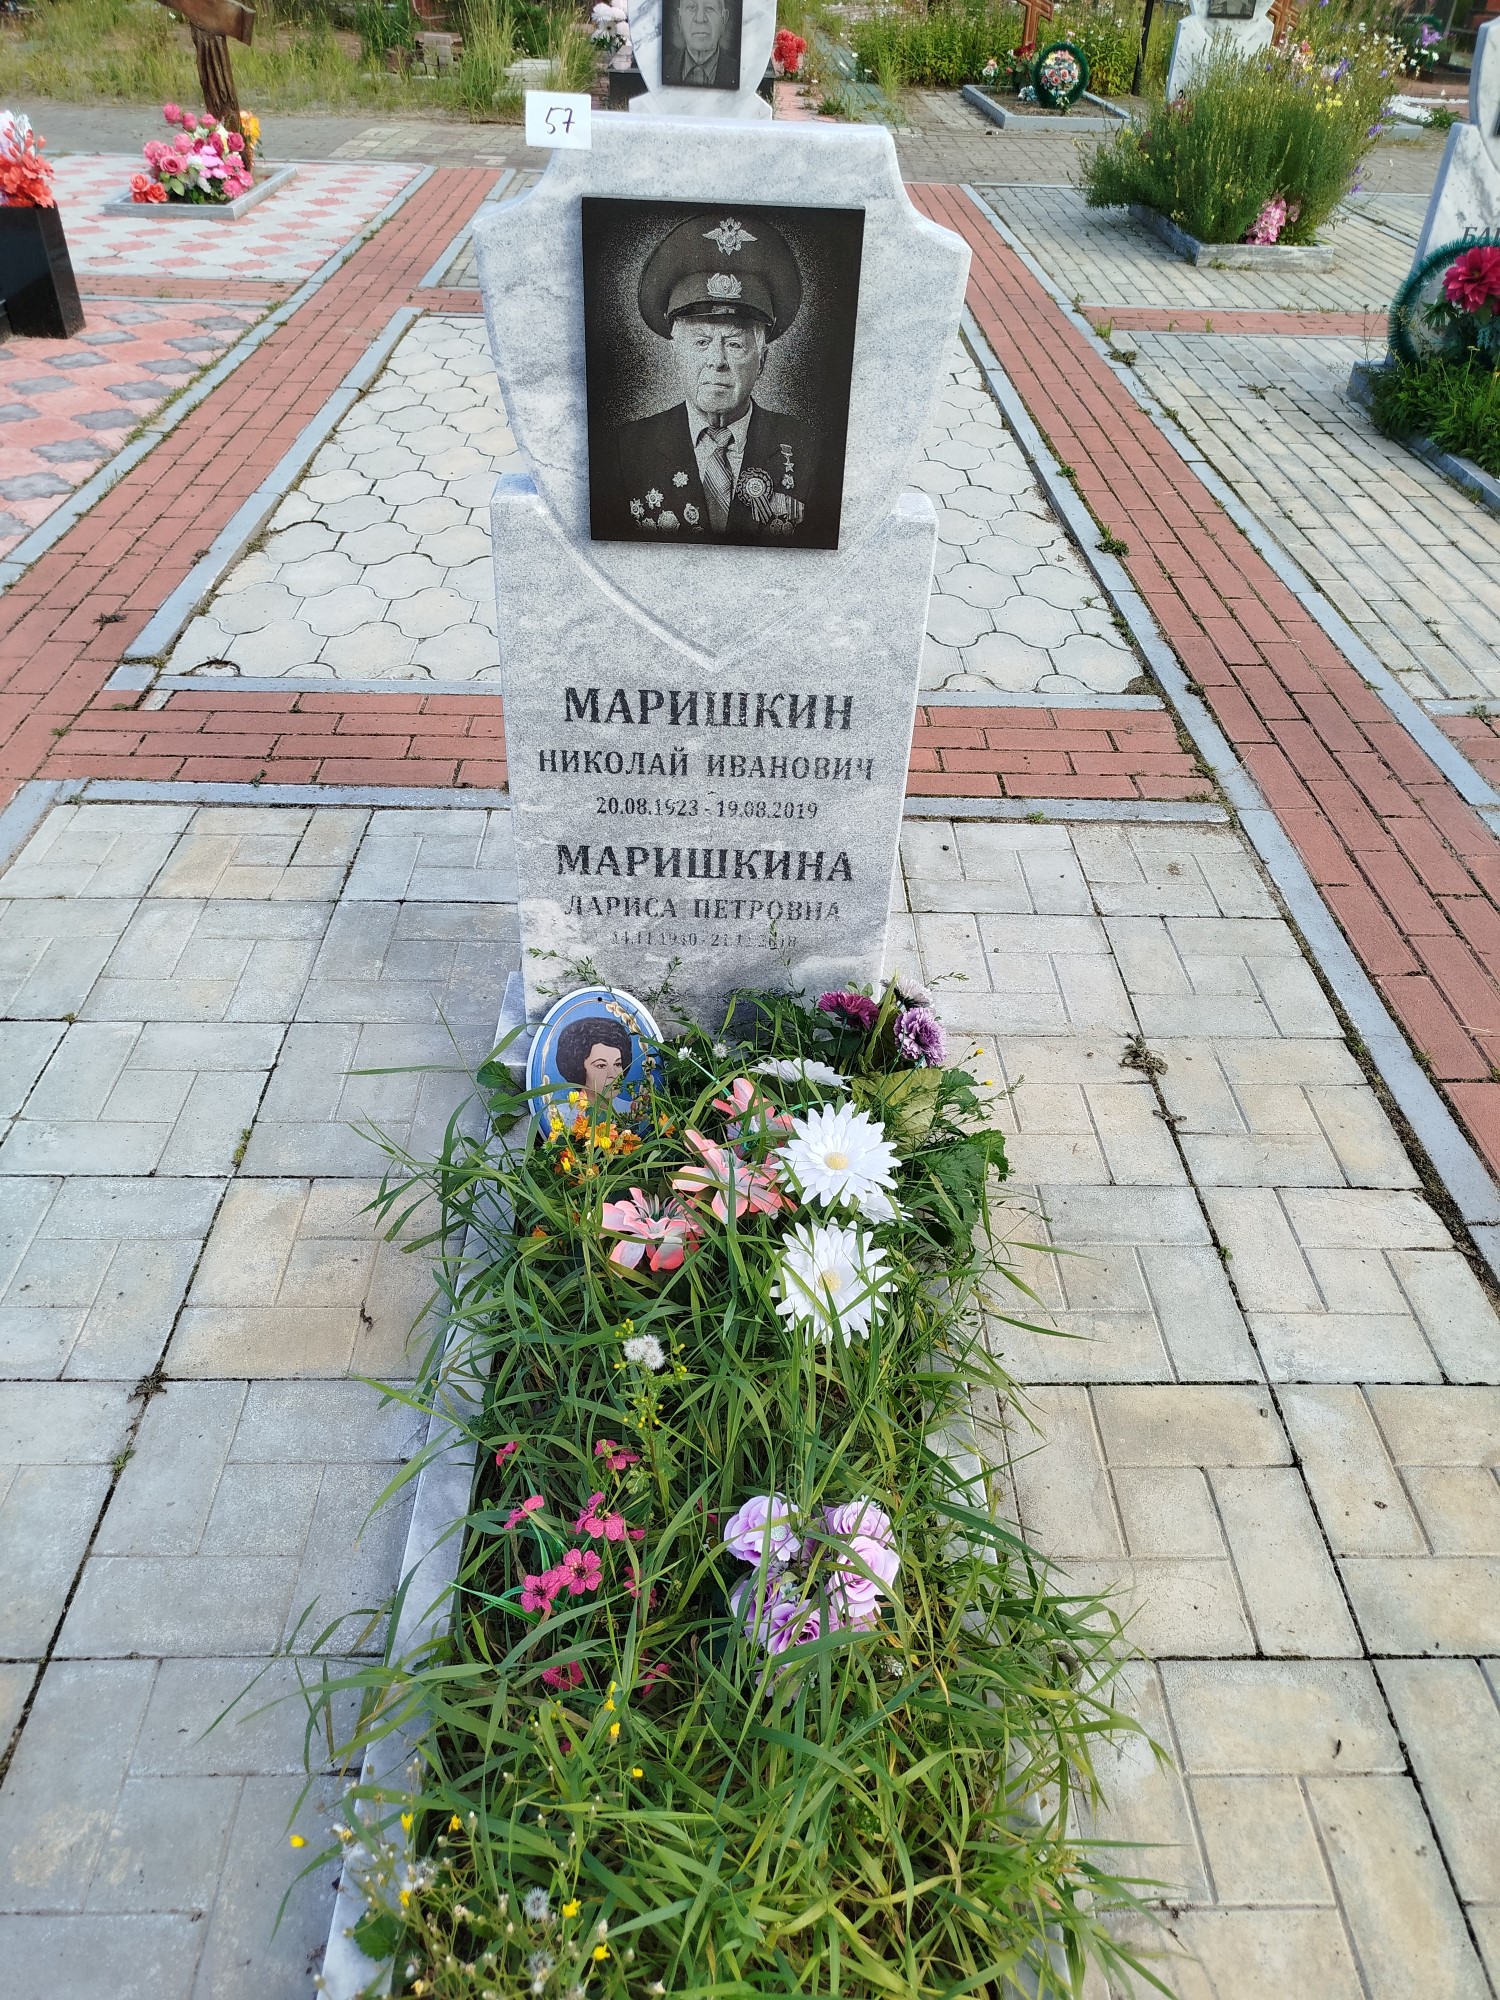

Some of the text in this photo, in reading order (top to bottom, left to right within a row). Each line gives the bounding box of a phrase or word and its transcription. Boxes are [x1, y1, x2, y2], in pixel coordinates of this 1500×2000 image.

[545, 107, 575, 134] 57
[564, 687, 853, 729] МАРИШКИН
[538, 747, 874, 780] НИКОЛАЙ ИВАНОВИЧ
[596, 796, 699, 817] 20.08.1923
[716, 800, 818, 819] 19.08.2019
[556, 844, 853, 881] МАРИШКИНА
[564, 896, 841, 921] ЛАРИСА ПЕТРОВНА
